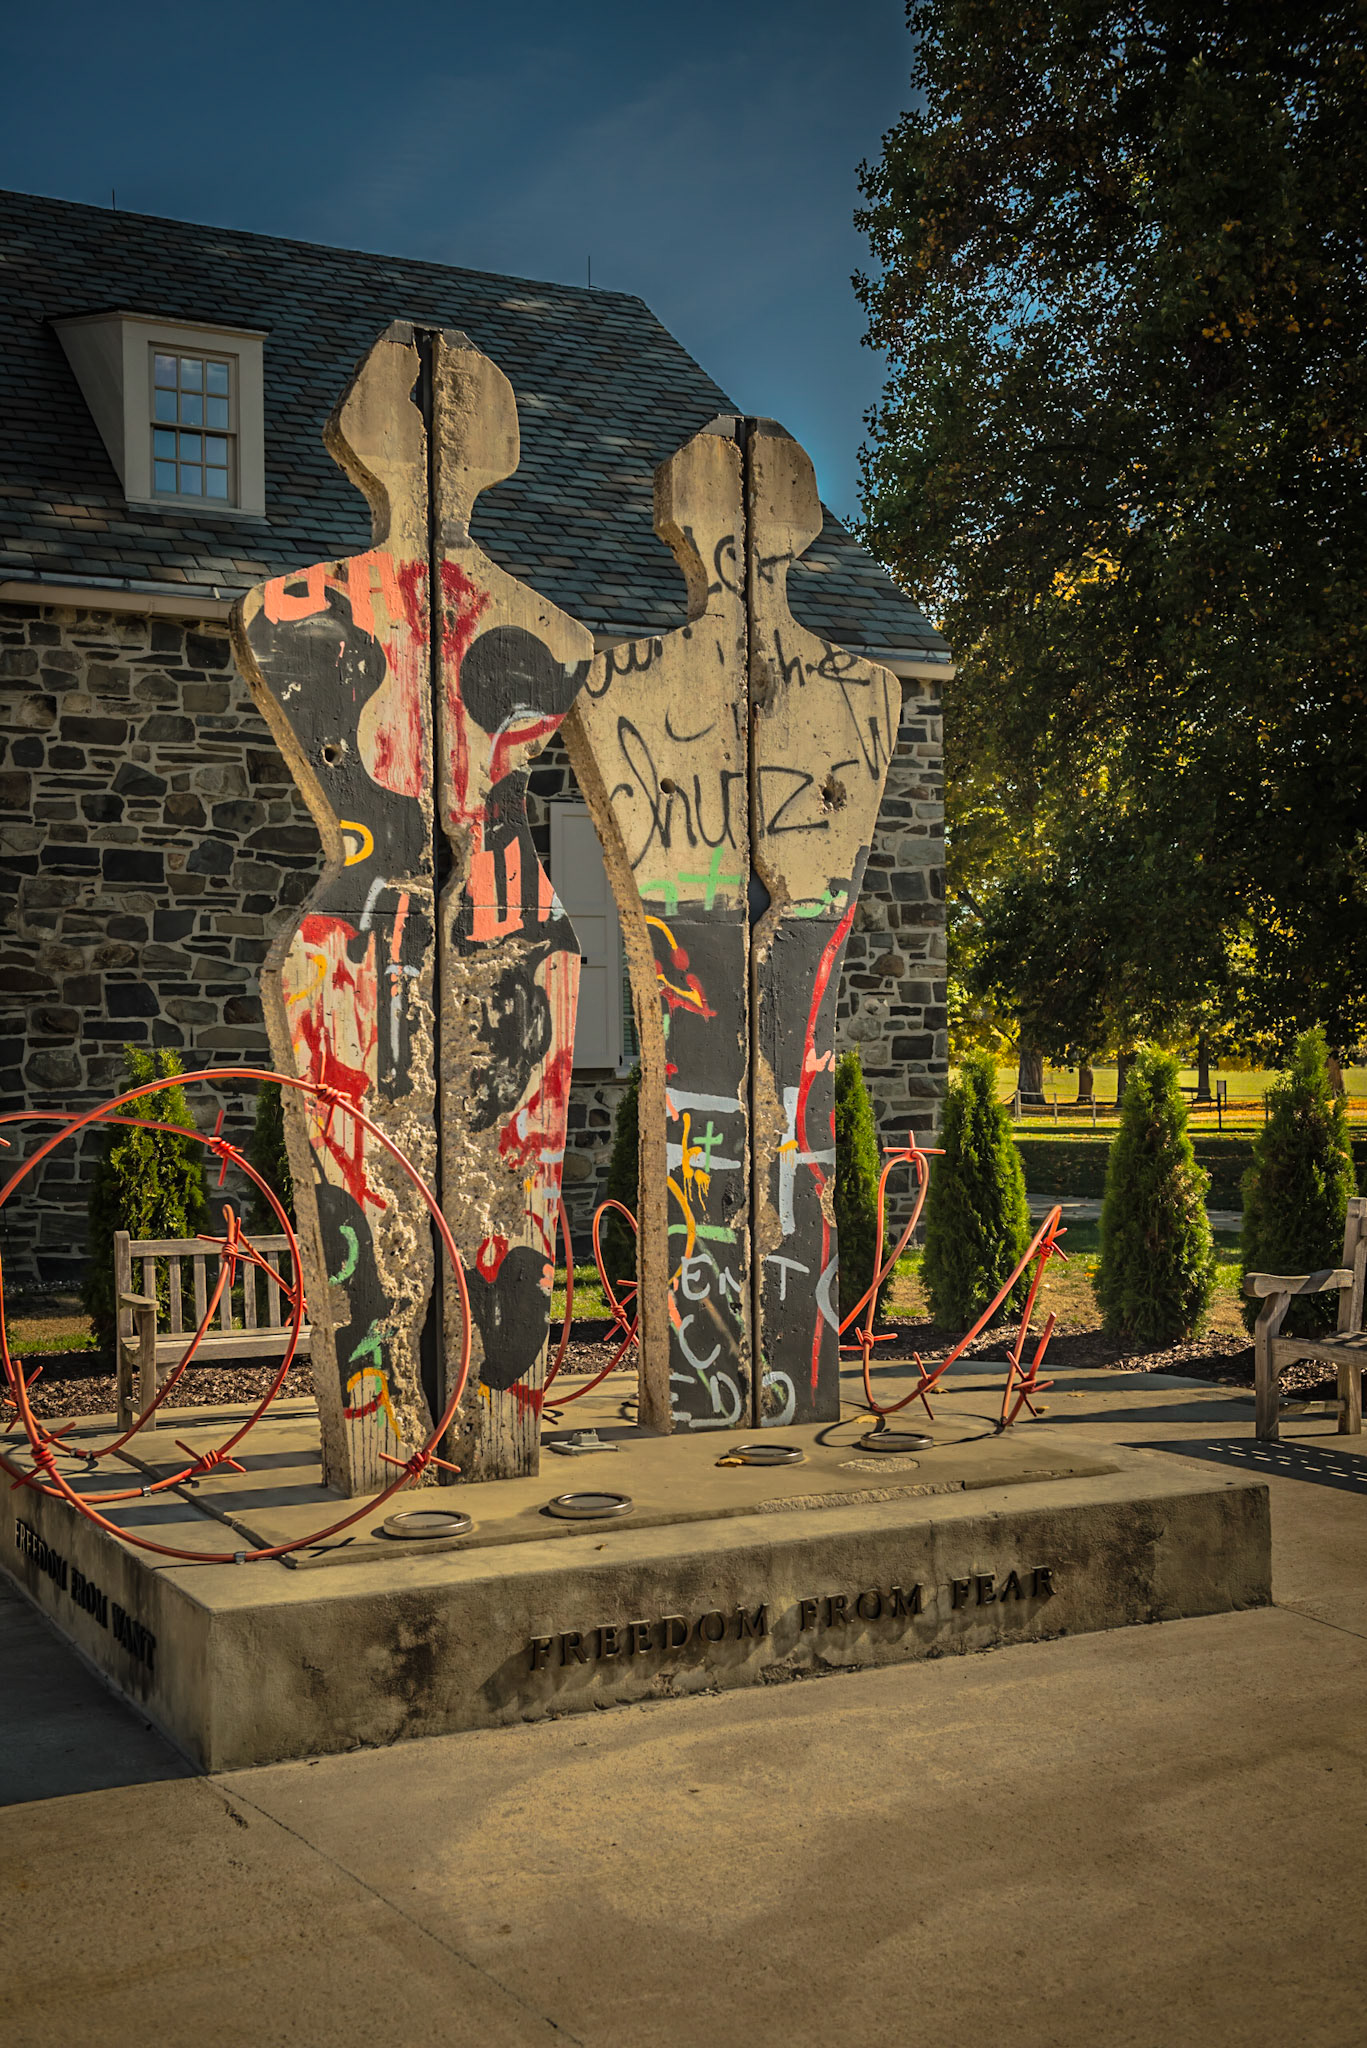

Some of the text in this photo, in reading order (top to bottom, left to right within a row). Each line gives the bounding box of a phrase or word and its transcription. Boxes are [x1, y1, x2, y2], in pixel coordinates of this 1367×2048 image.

[529, 1564, 1057, 1671] FREEDOM FROM FEAR
